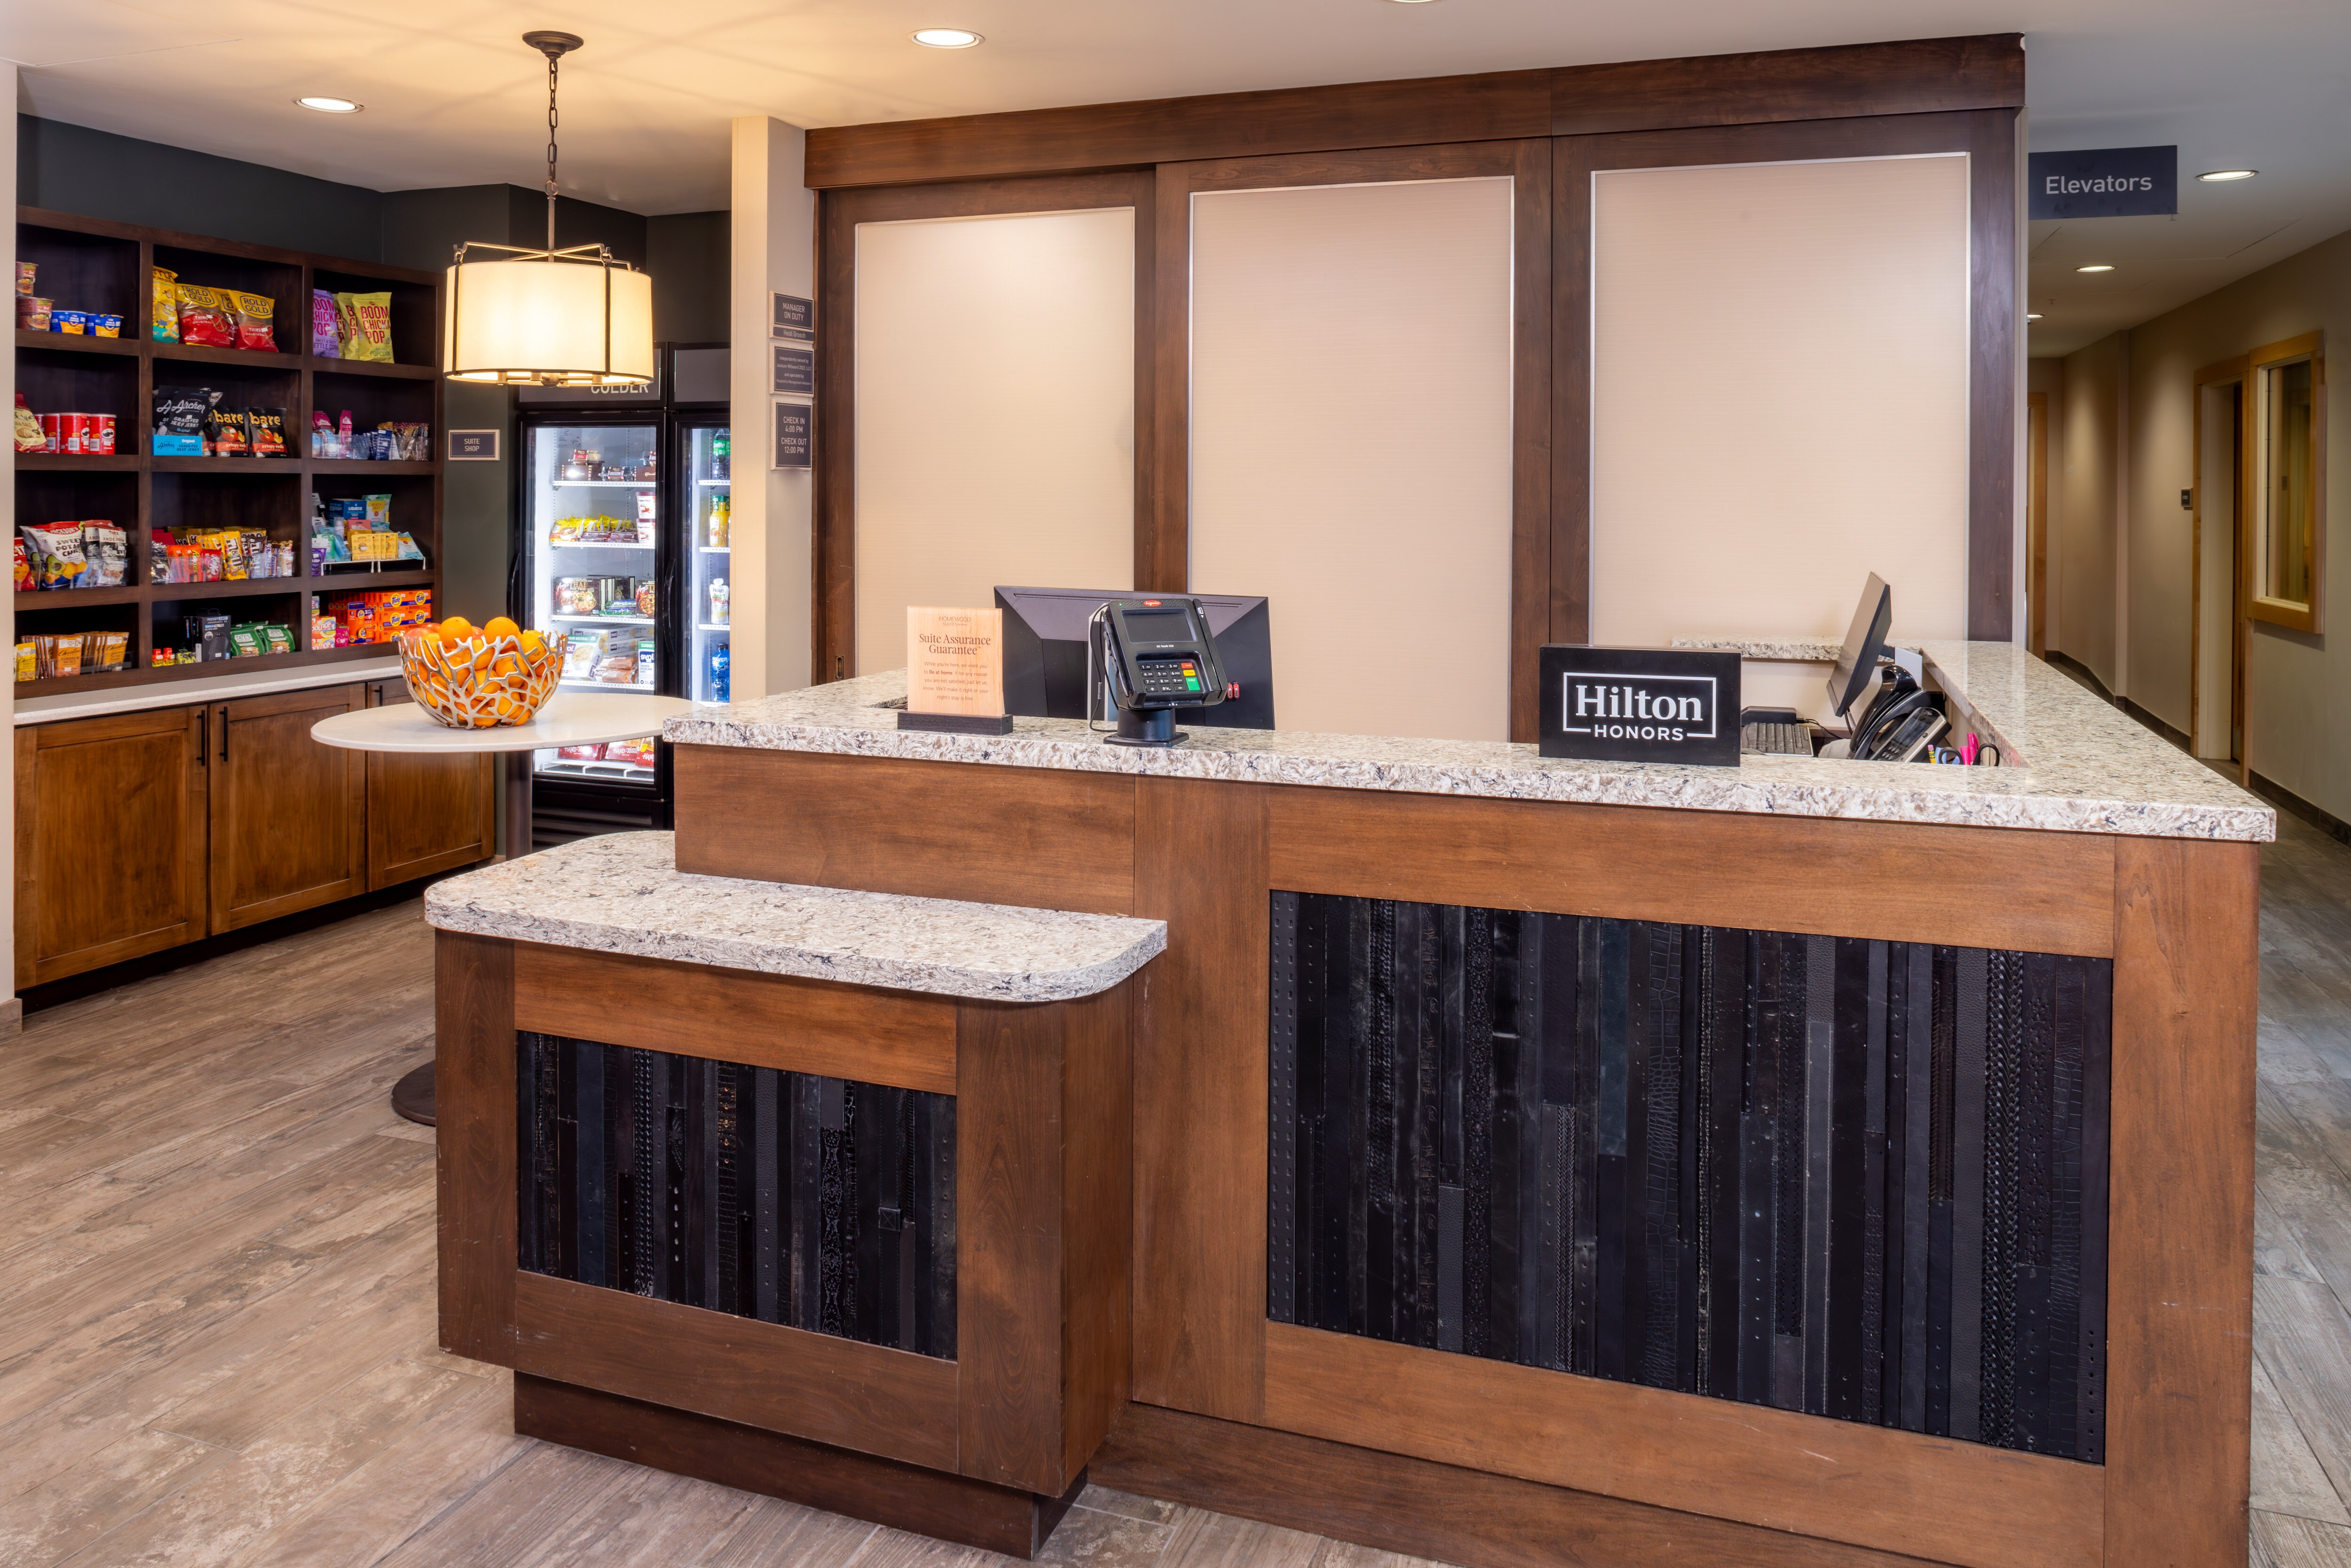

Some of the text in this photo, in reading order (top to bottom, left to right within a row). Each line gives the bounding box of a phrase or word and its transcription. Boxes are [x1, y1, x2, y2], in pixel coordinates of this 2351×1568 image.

[2046, 175, 2152, 194] Elevators
[187, 287, 208, 297] ROLD
[189, 294, 212, 304] GOLD
[245, 298, 266, 307] ROLD
[360, 306, 389, 319] BOOM
[783, 302, 805, 313] MANAGER
[792, 313, 804, 321] DUTY
[363, 320, 391, 330] CHICKA
[365, 331, 385, 344] POP
[171, 400, 205, 414] Archer
[213, 409, 244, 424] bare
[248, 411, 281, 425] bare
[636, 585, 649, 595] Amy's
[391, 596, 401, 605] Tide
[415, 594, 425, 603] Tide
[391, 616, 401, 624] Tide
[415, 614, 425, 622] Tide
[919, 634, 991, 645] Suite Assurance
[1576, 685, 1703, 721] Hilton
[1594, 724, 1683, 741] HONORS
